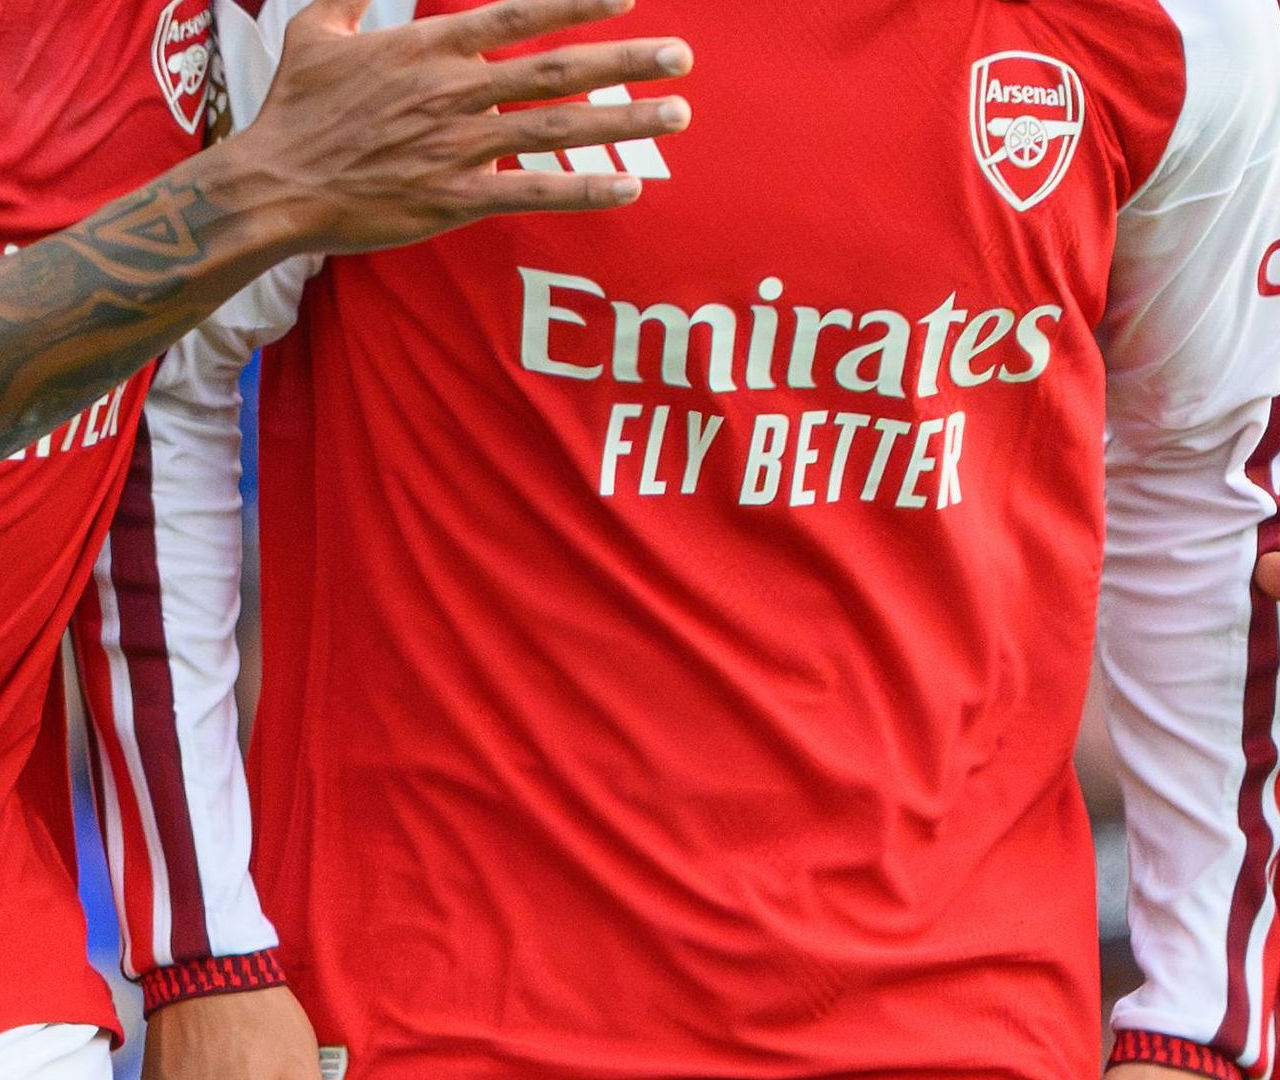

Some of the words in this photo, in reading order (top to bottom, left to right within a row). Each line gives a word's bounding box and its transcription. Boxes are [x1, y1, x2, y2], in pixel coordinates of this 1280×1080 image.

[986, 77, 1066, 108] Arsenal
[517, 267, 1062, 398] Emirates
[600, 403, 724, 497] FLY
[738, 410, 966, 509] BETTER
